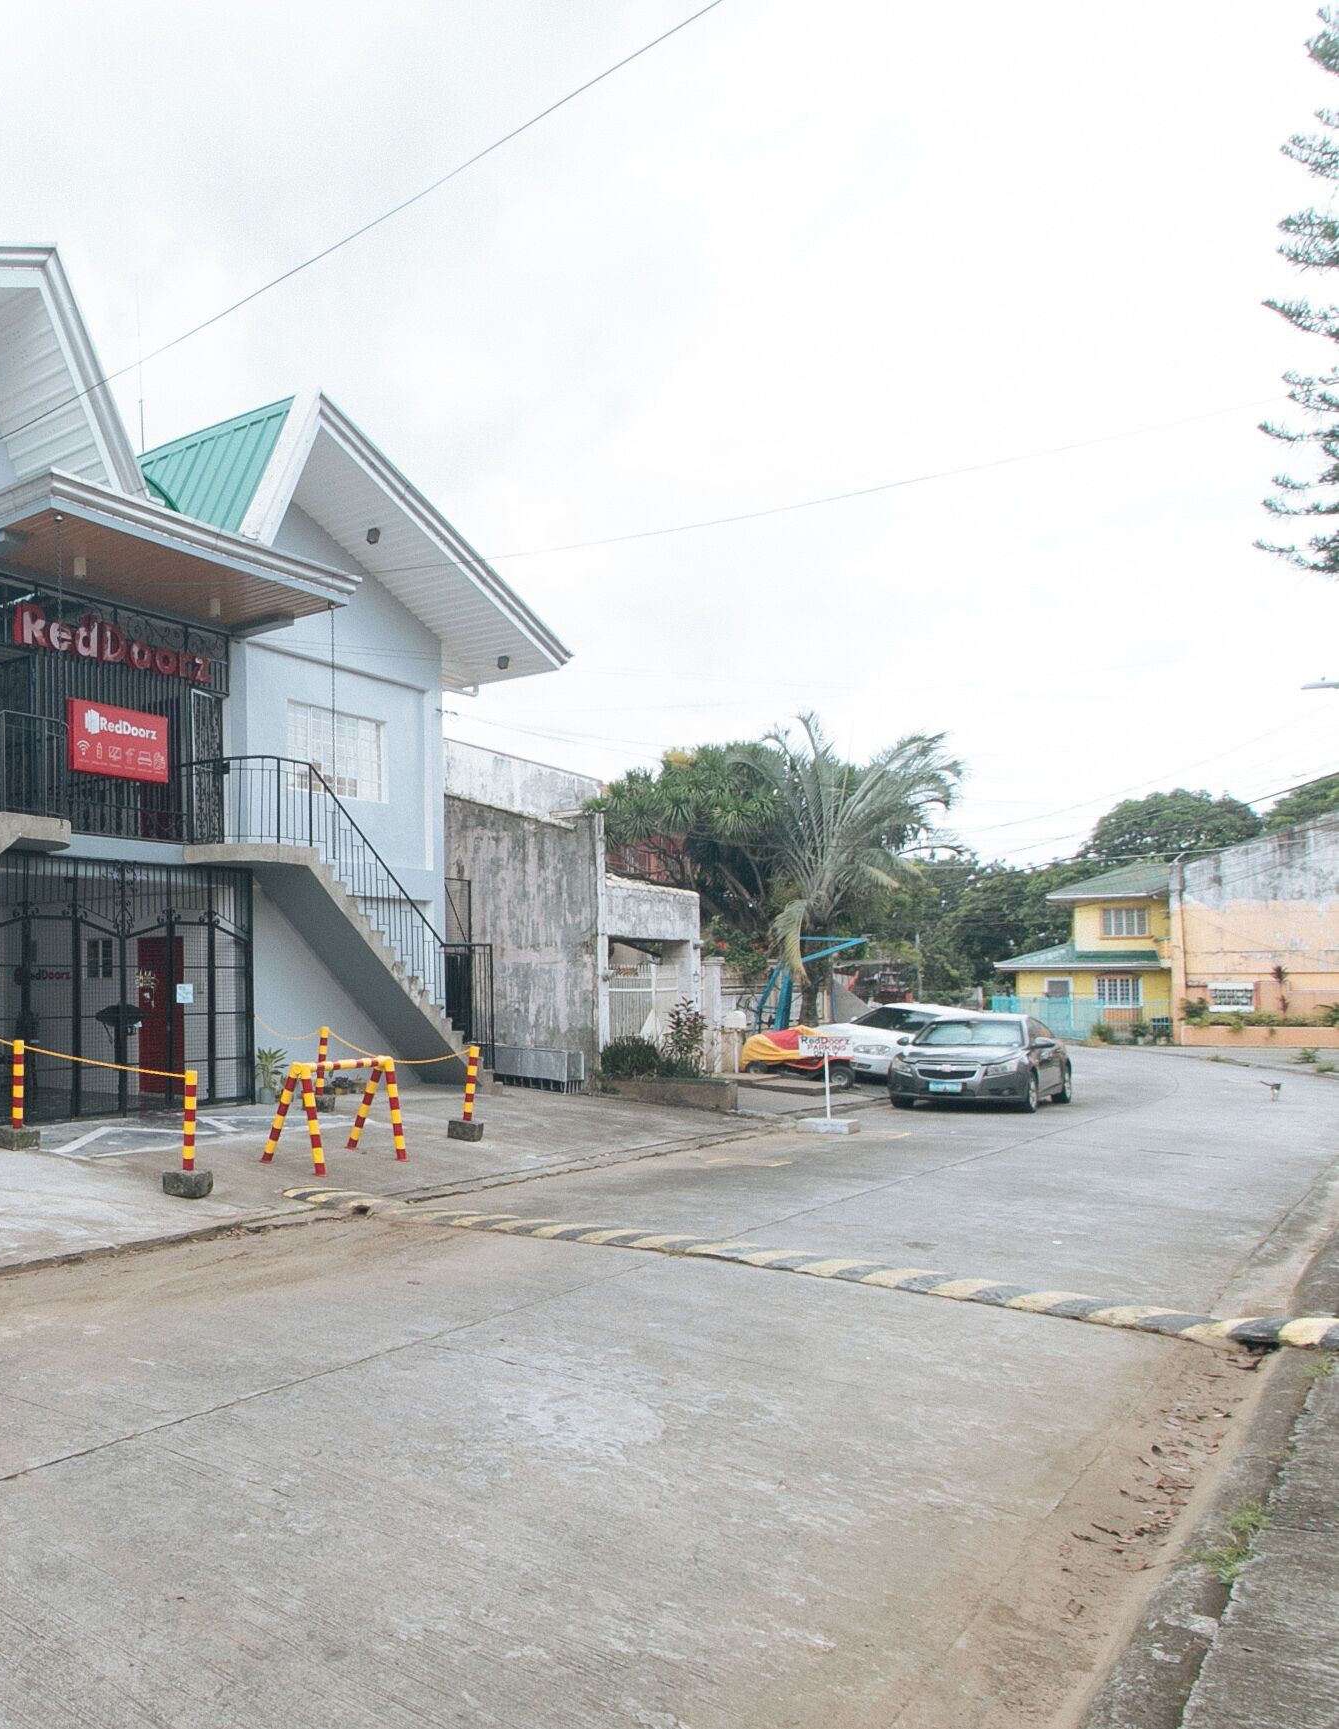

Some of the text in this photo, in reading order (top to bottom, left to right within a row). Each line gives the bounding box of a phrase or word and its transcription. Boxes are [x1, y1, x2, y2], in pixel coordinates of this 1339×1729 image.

[14, 603, 211, 682] RedDoorz
[99, 716, 158, 740] RedDoorz
[801, 1036, 850, 1045] RedDoorz
